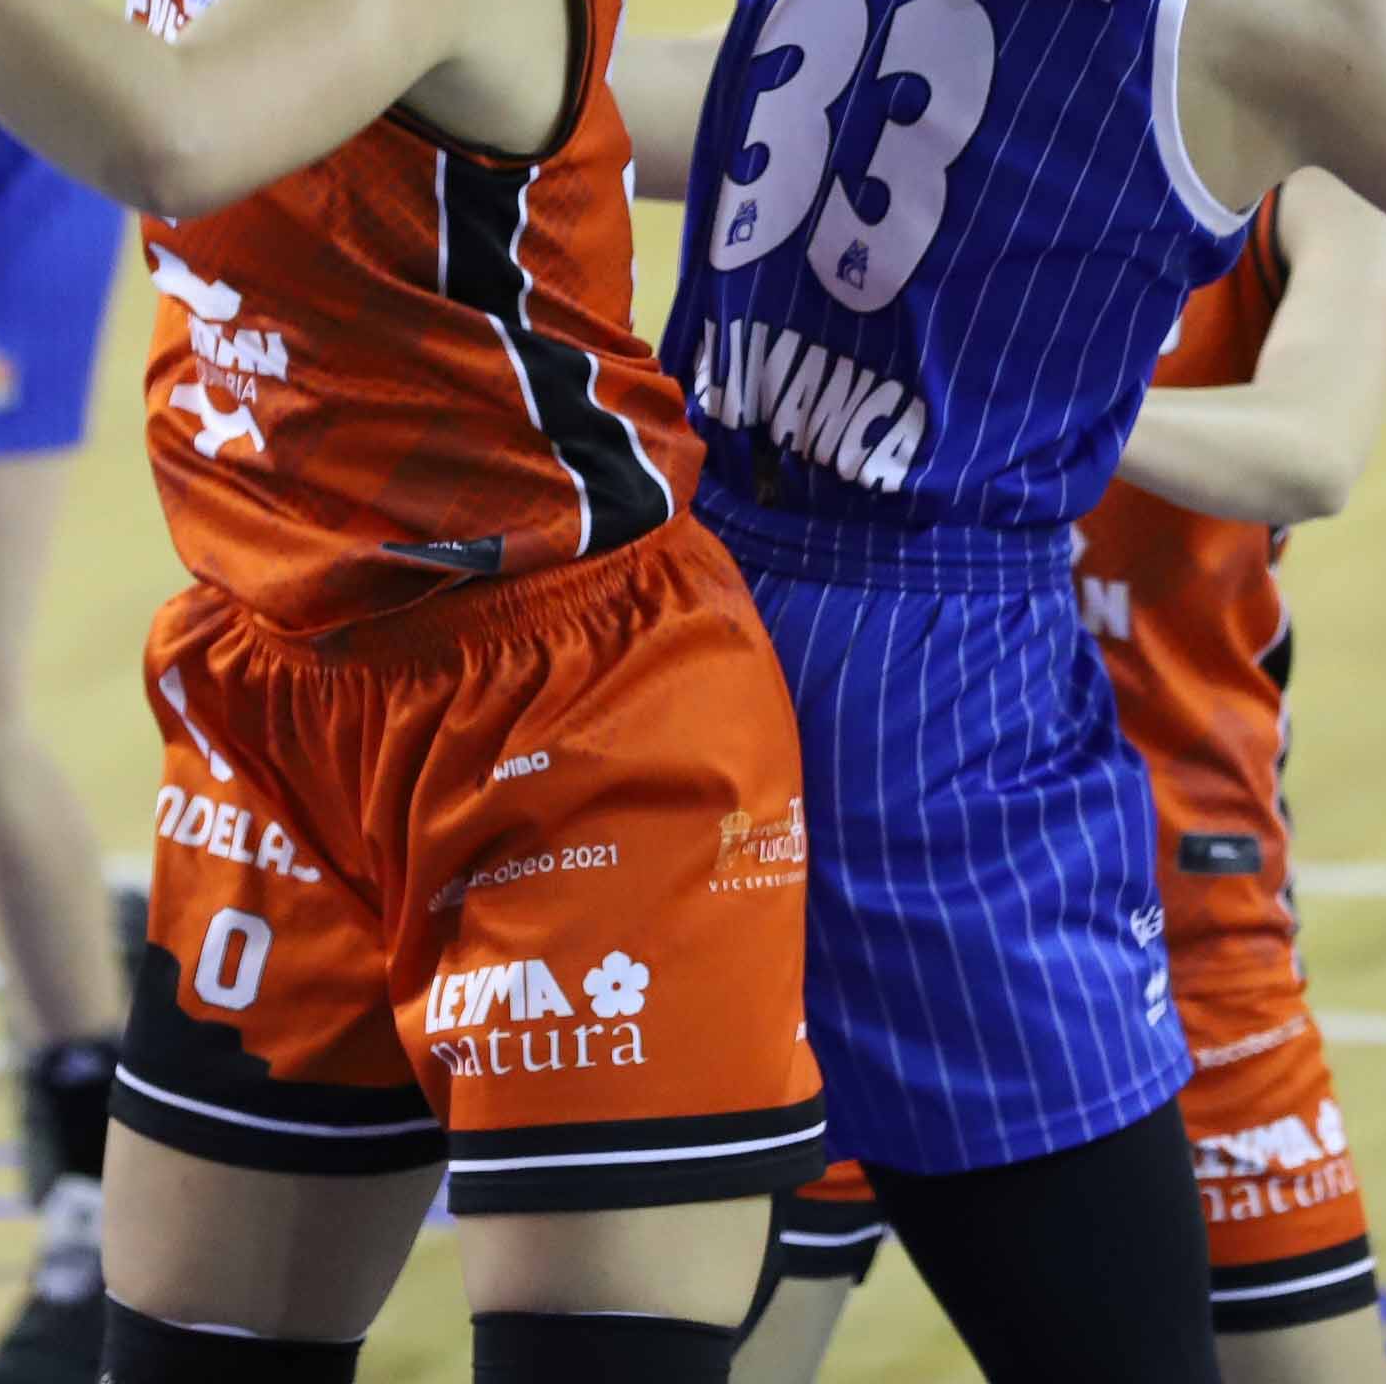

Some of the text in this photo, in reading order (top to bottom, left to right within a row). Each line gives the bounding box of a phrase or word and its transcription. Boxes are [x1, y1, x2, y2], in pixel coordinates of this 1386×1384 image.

[560, 844, 619, 871] 2021
[193, 907, 273, 1010] 0
[425, 959, 575, 1035] LEYMA
[430, 1021, 648, 1078] natura
